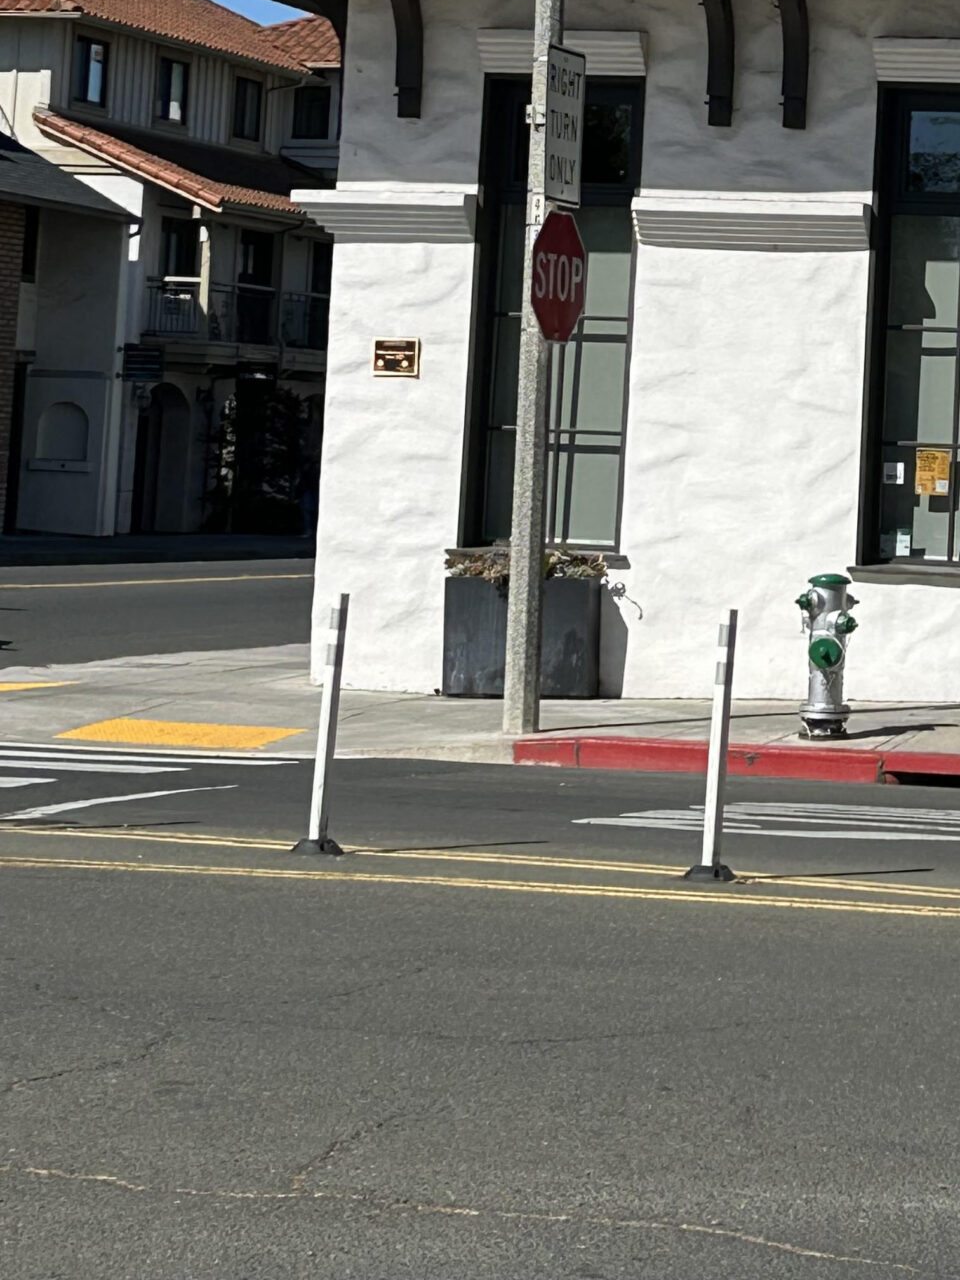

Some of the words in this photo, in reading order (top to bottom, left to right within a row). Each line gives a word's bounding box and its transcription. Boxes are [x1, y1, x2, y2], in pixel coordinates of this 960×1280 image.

[549, 63, 583, 100] RIGHT
[549, 109, 578, 142] TURN
[549, 154, 577, 185] ONLY
[534, 250, 584, 303] STOP
